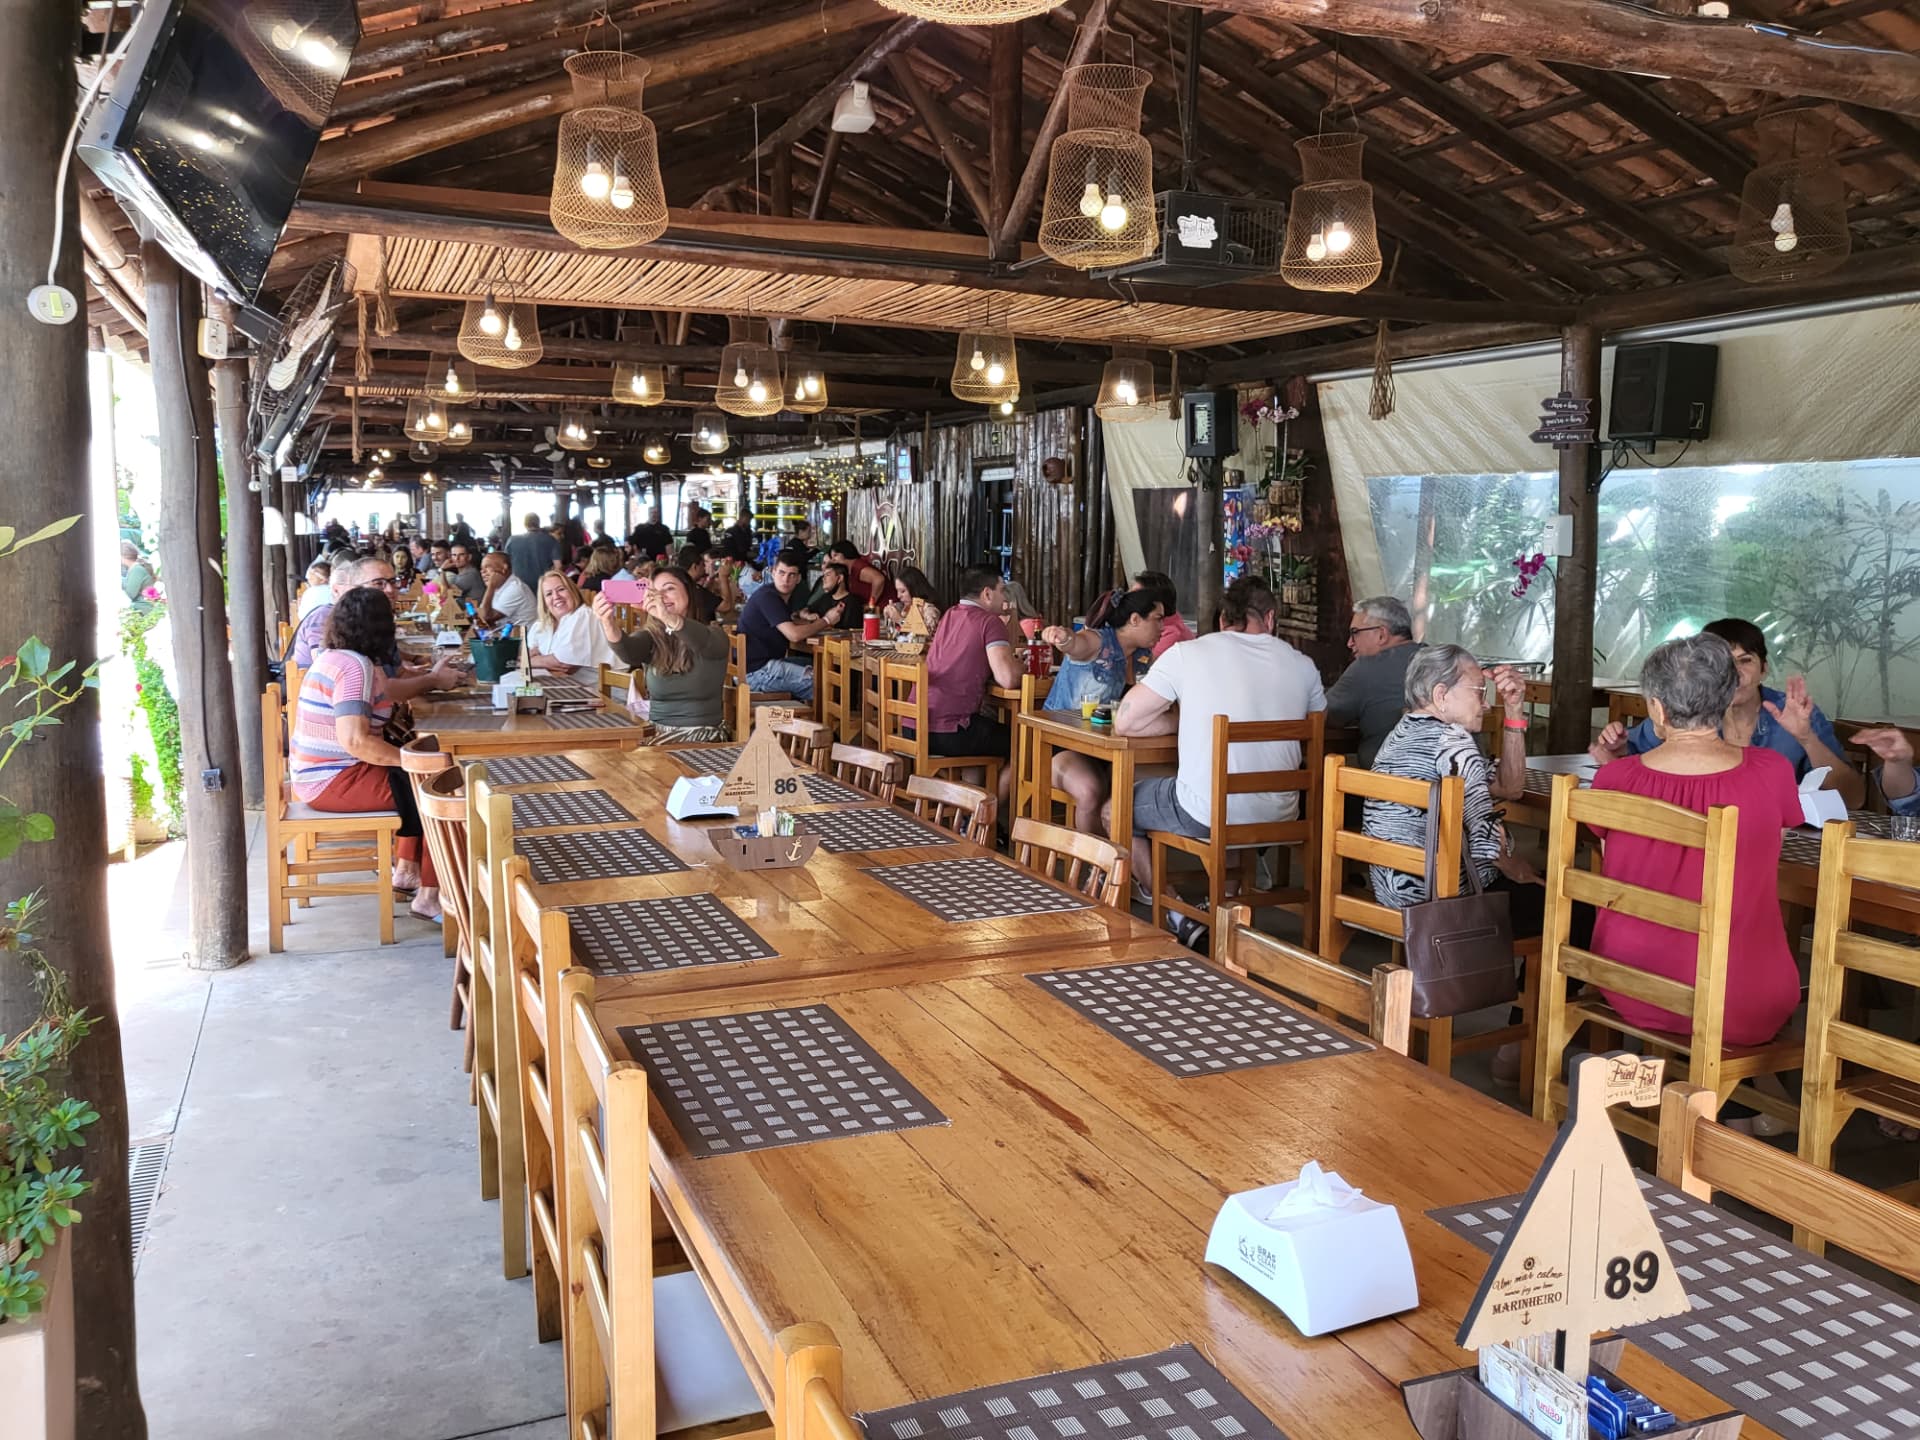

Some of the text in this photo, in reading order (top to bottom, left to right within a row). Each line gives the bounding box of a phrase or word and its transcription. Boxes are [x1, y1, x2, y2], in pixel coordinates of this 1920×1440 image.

[774, 777, 798, 795] 86
[1257, 1245, 1276, 1263] BRAS
[1514, 1272, 1534, 1283] mar
[1604, 1250, 1660, 1300] 89
[1492, 1291, 1562, 1315] MARINHEIRO
